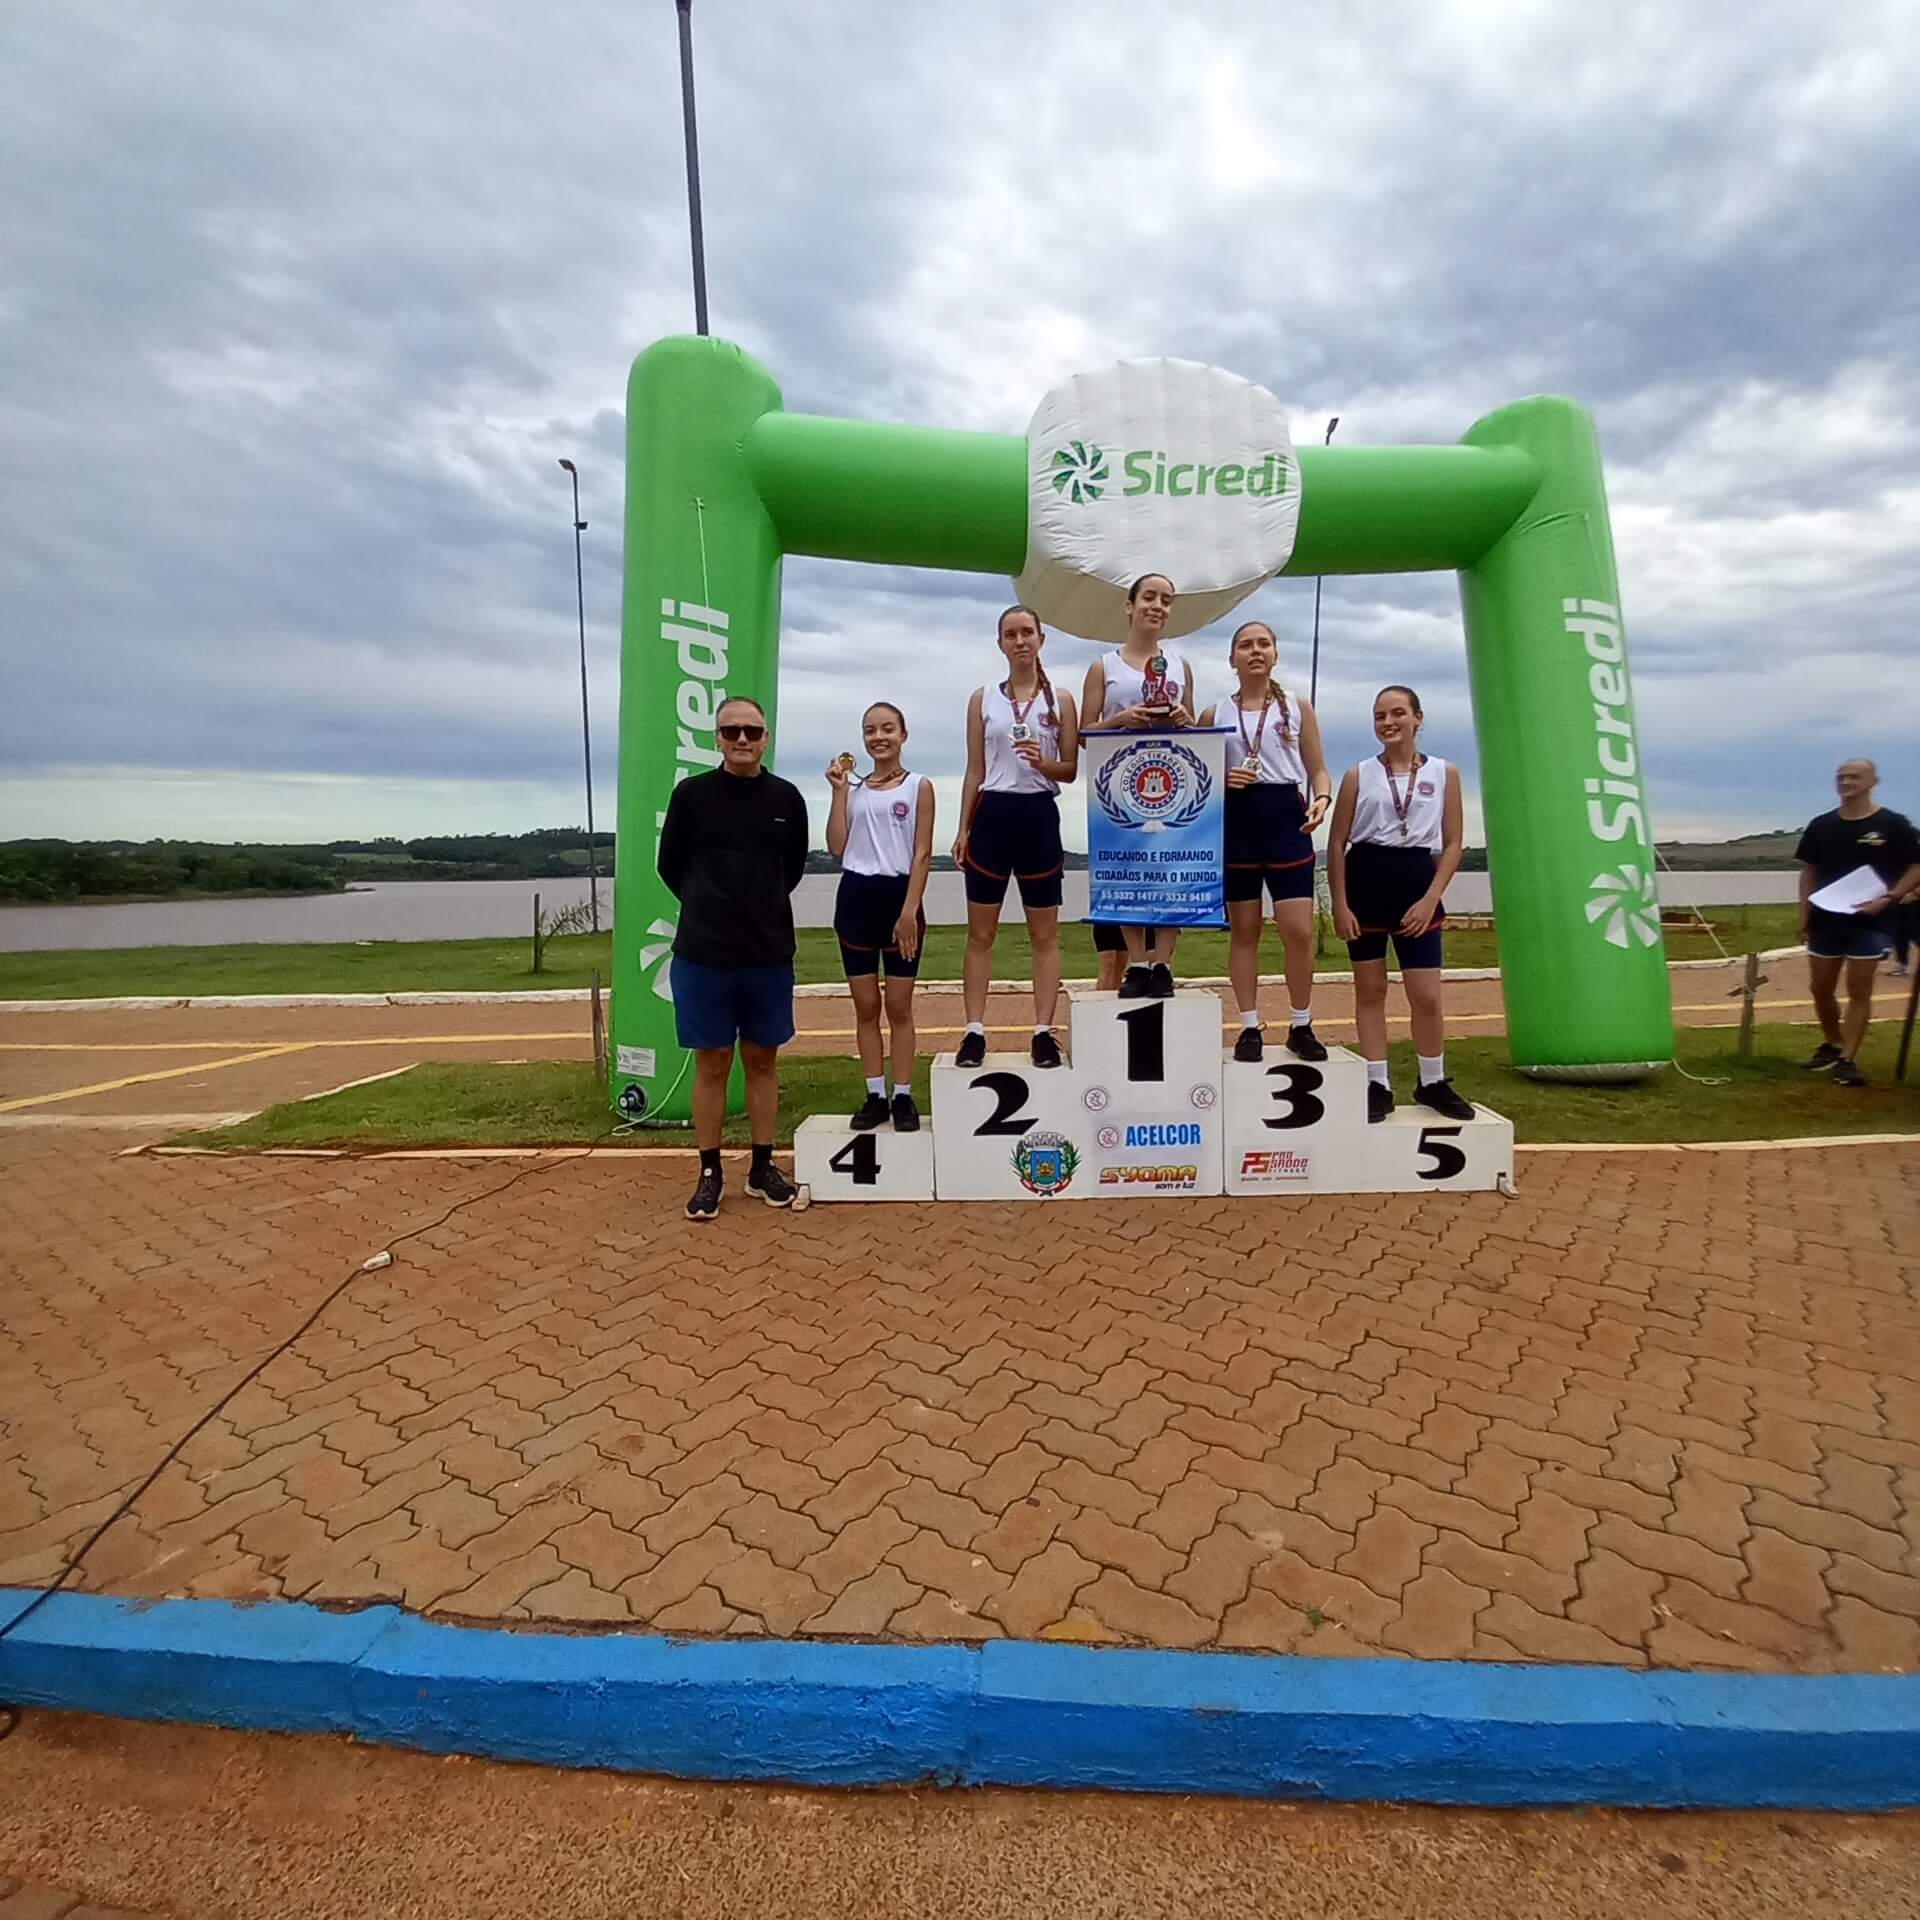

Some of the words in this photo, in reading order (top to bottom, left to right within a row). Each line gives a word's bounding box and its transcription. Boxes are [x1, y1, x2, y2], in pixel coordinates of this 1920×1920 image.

[1123, 450, 1288, 497] Sicredi
[1562, 597, 1646, 847] Sicredi
[1095, 869, 1141, 881] CIDADÃOS
[1143, 871, 1168, 882] PARA
[1170, 872, 1177, 882] O
[1180, 871, 1217, 882] MUNDO
[1098, 850, 1148, 862] EDUCANDO
[1151, 851, 1157, 862] E
[1159, 850, 1214, 862] FORMANDO
[1117, 1001, 1164, 1082] 1
[969, 1072, 1039, 1136] 2
[1263, 1064, 1326, 1129] 3
[829, 1134, 882, 1185] 4
[1125, 1123, 1201, 1147] ACELCOR
[1416, 1127, 1466, 1179] 5
